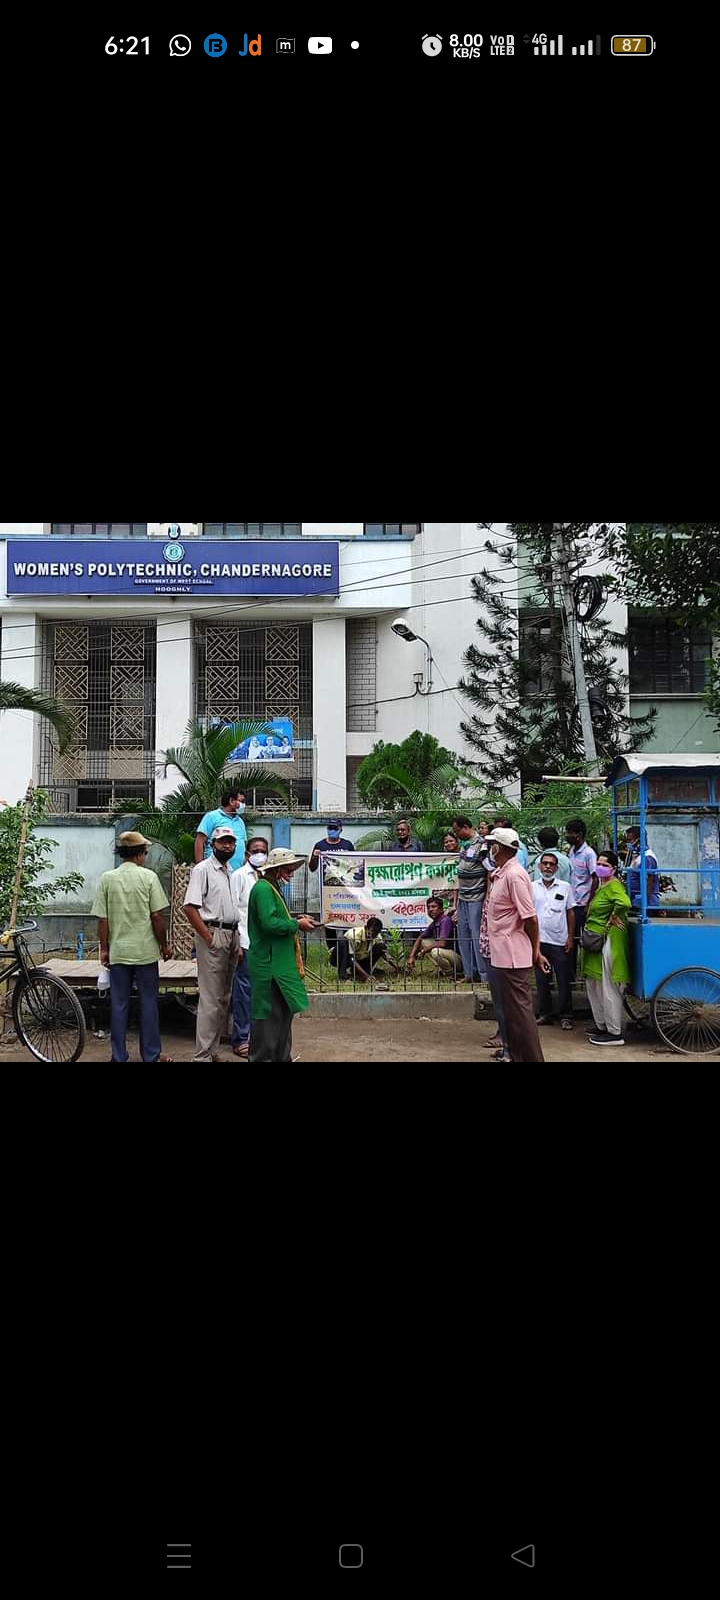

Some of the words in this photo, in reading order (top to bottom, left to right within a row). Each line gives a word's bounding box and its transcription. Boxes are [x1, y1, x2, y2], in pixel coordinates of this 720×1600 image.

[13, 562, 84, 577] WOMEN'S
[87, 562, 198, 578] POLYTECHNIC,
[199, 562, 333, 578] CHANDERNAGORE
